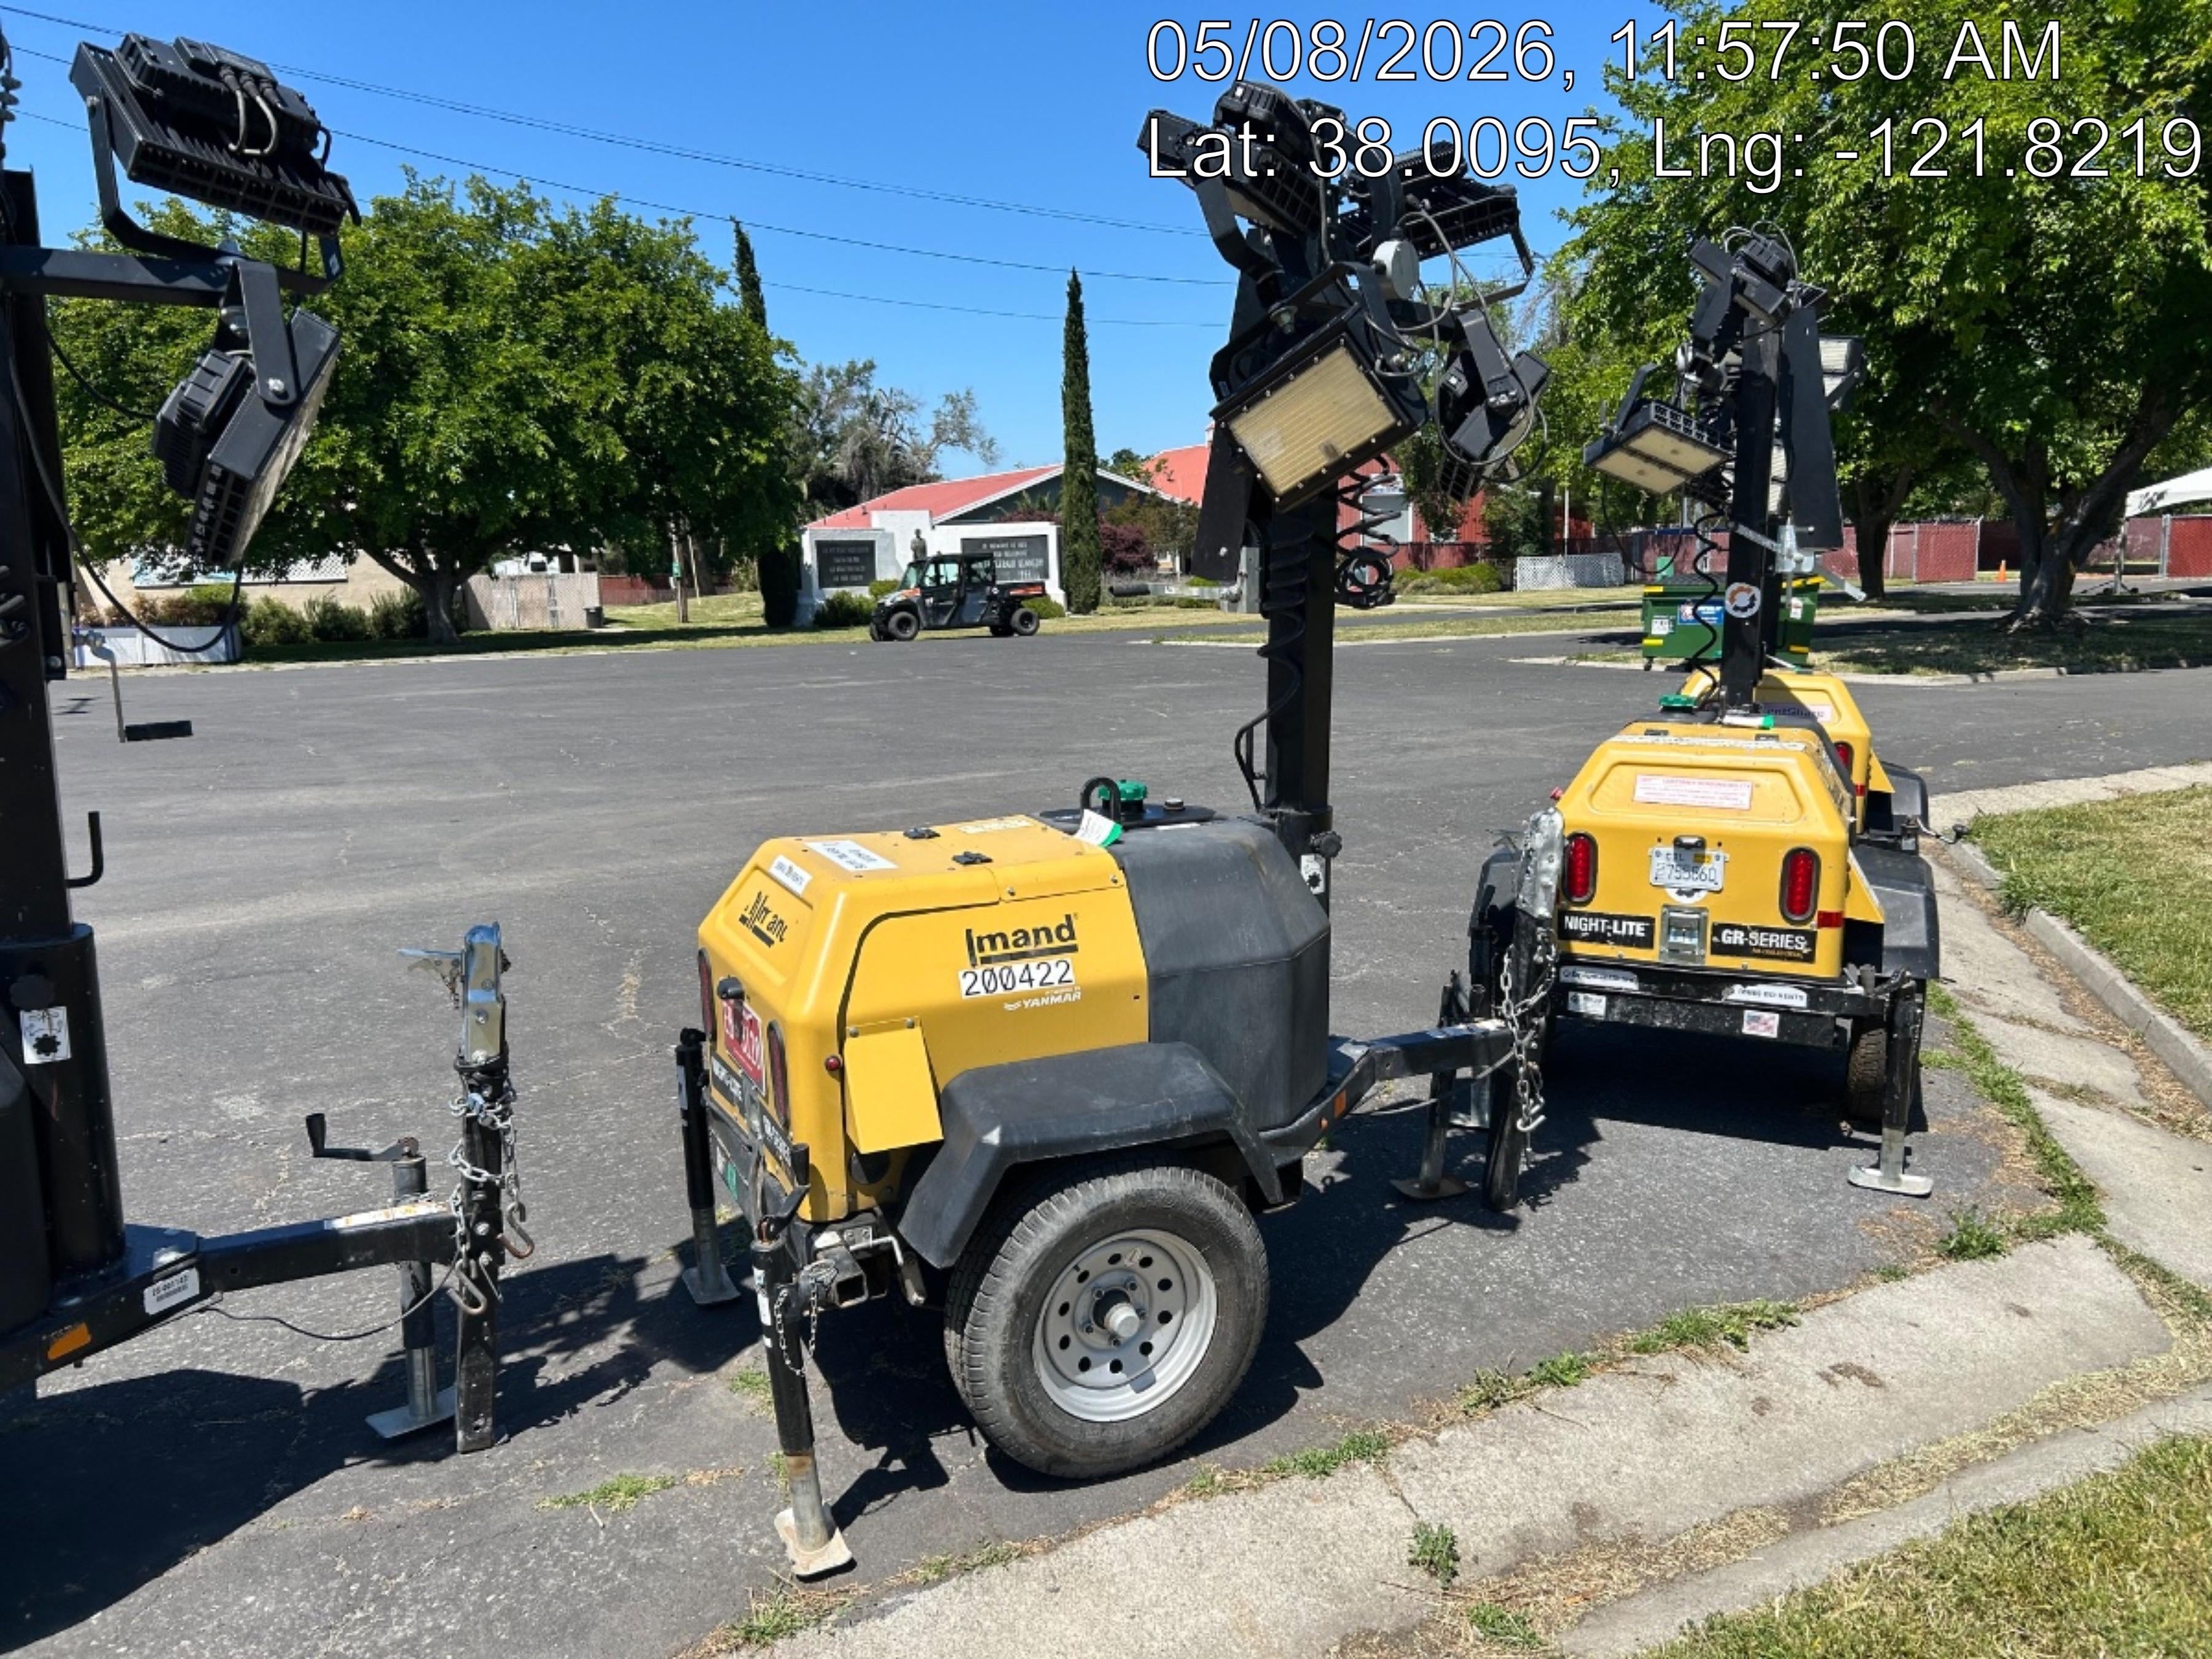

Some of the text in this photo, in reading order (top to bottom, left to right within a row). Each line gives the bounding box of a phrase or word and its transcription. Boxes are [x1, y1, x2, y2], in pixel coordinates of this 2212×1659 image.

[1564, 915, 1646, 937] NIGHT-LITE
[1721, 928, 1806, 950] GR-SERIES
[961, 959, 1073, 997] 200422
[1022, 990, 1081, 1008] YANMAR
